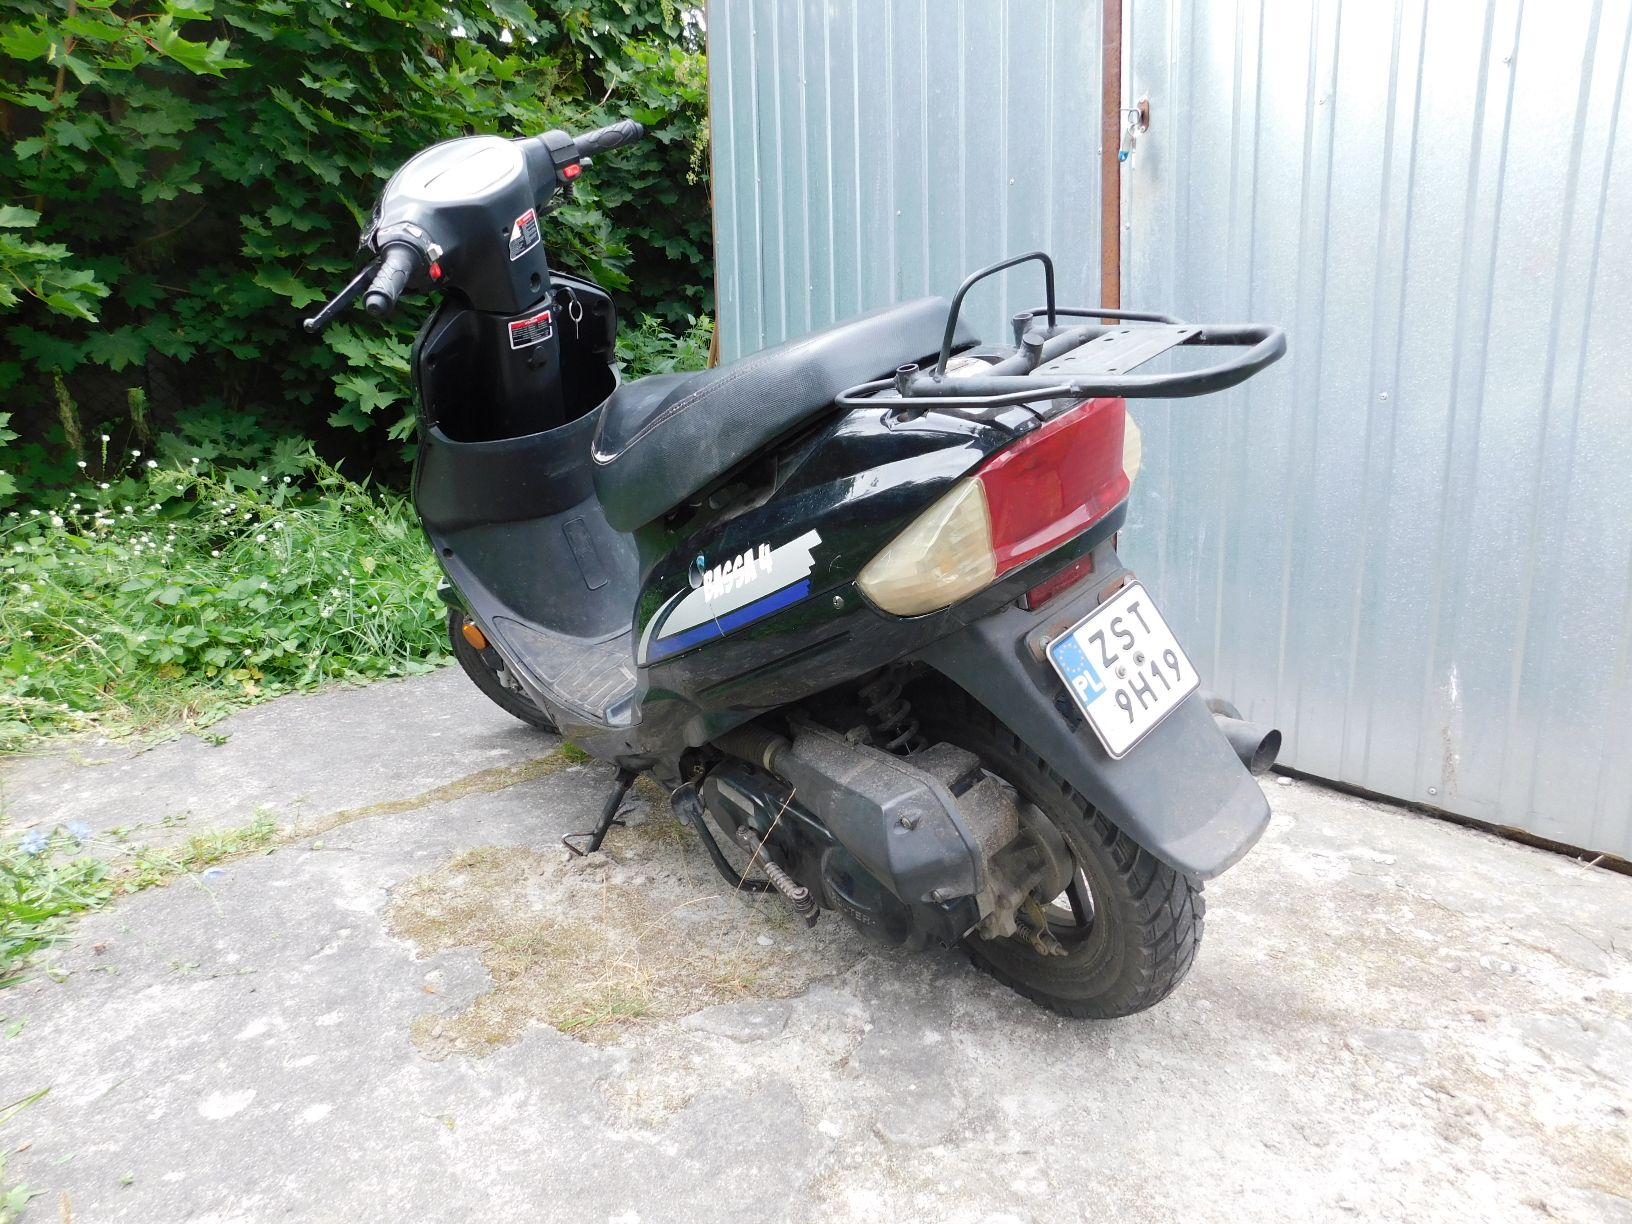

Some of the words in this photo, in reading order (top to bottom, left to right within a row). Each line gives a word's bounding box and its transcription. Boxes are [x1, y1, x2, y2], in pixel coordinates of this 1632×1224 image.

[703, 548, 757, 603] BASSA
[1088, 601, 1151, 668] ZST
[1071, 671, 1104, 702] PL
[1114, 648, 1181, 723] 9H19
